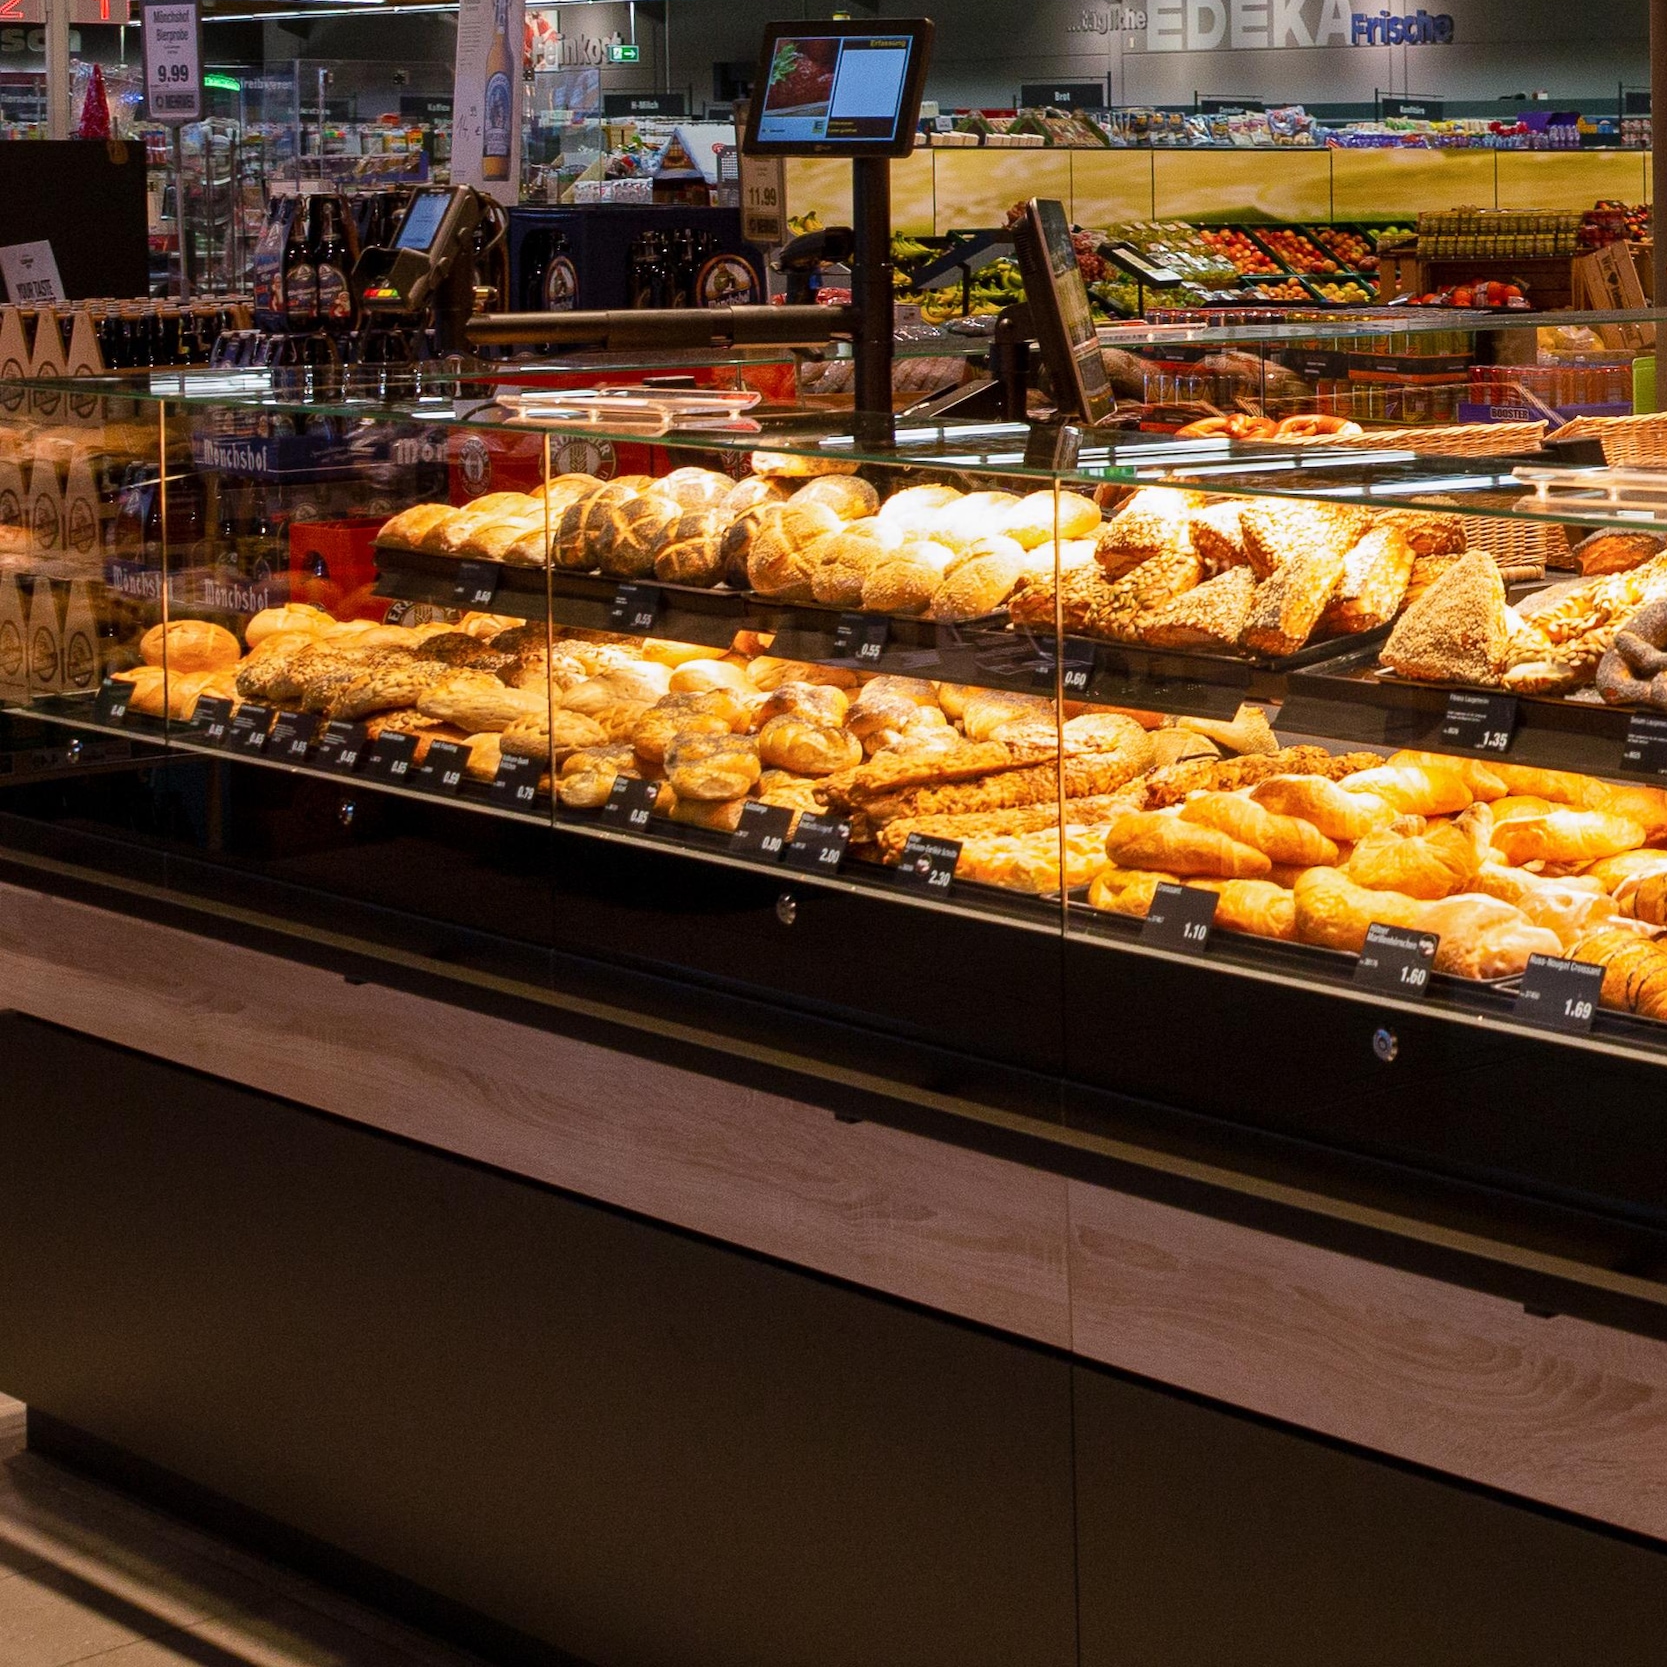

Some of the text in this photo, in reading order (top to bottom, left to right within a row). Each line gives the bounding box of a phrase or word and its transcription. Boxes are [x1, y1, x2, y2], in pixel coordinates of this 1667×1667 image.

[1351, 10, 1453, 46] Frische
[157, 64, 189, 83] 9.99
[1053, 90, 1070, 102] Brot
[749, 186, 777, 207] 11.99
[1491, 408, 1529, 419] BOOSTER
[634, 612, 652, 625] 0.55
[861, 643, 881, 656] 0.55
[1063, 670, 1088, 686] 0.60
[1483, 731, 1509, 749] 1.35
[516, 785, 535, 801] 0.79
[760, 836, 782, 853] 0.80
[819, 847, 841, 865] 2.00
[928, 869, 952, 888] 2.30
[1183, 922, 1208, 941] 1.10
[1400, 966, 1427, 986] 1.60
[1564, 998, 1593, 1020] 1.69
